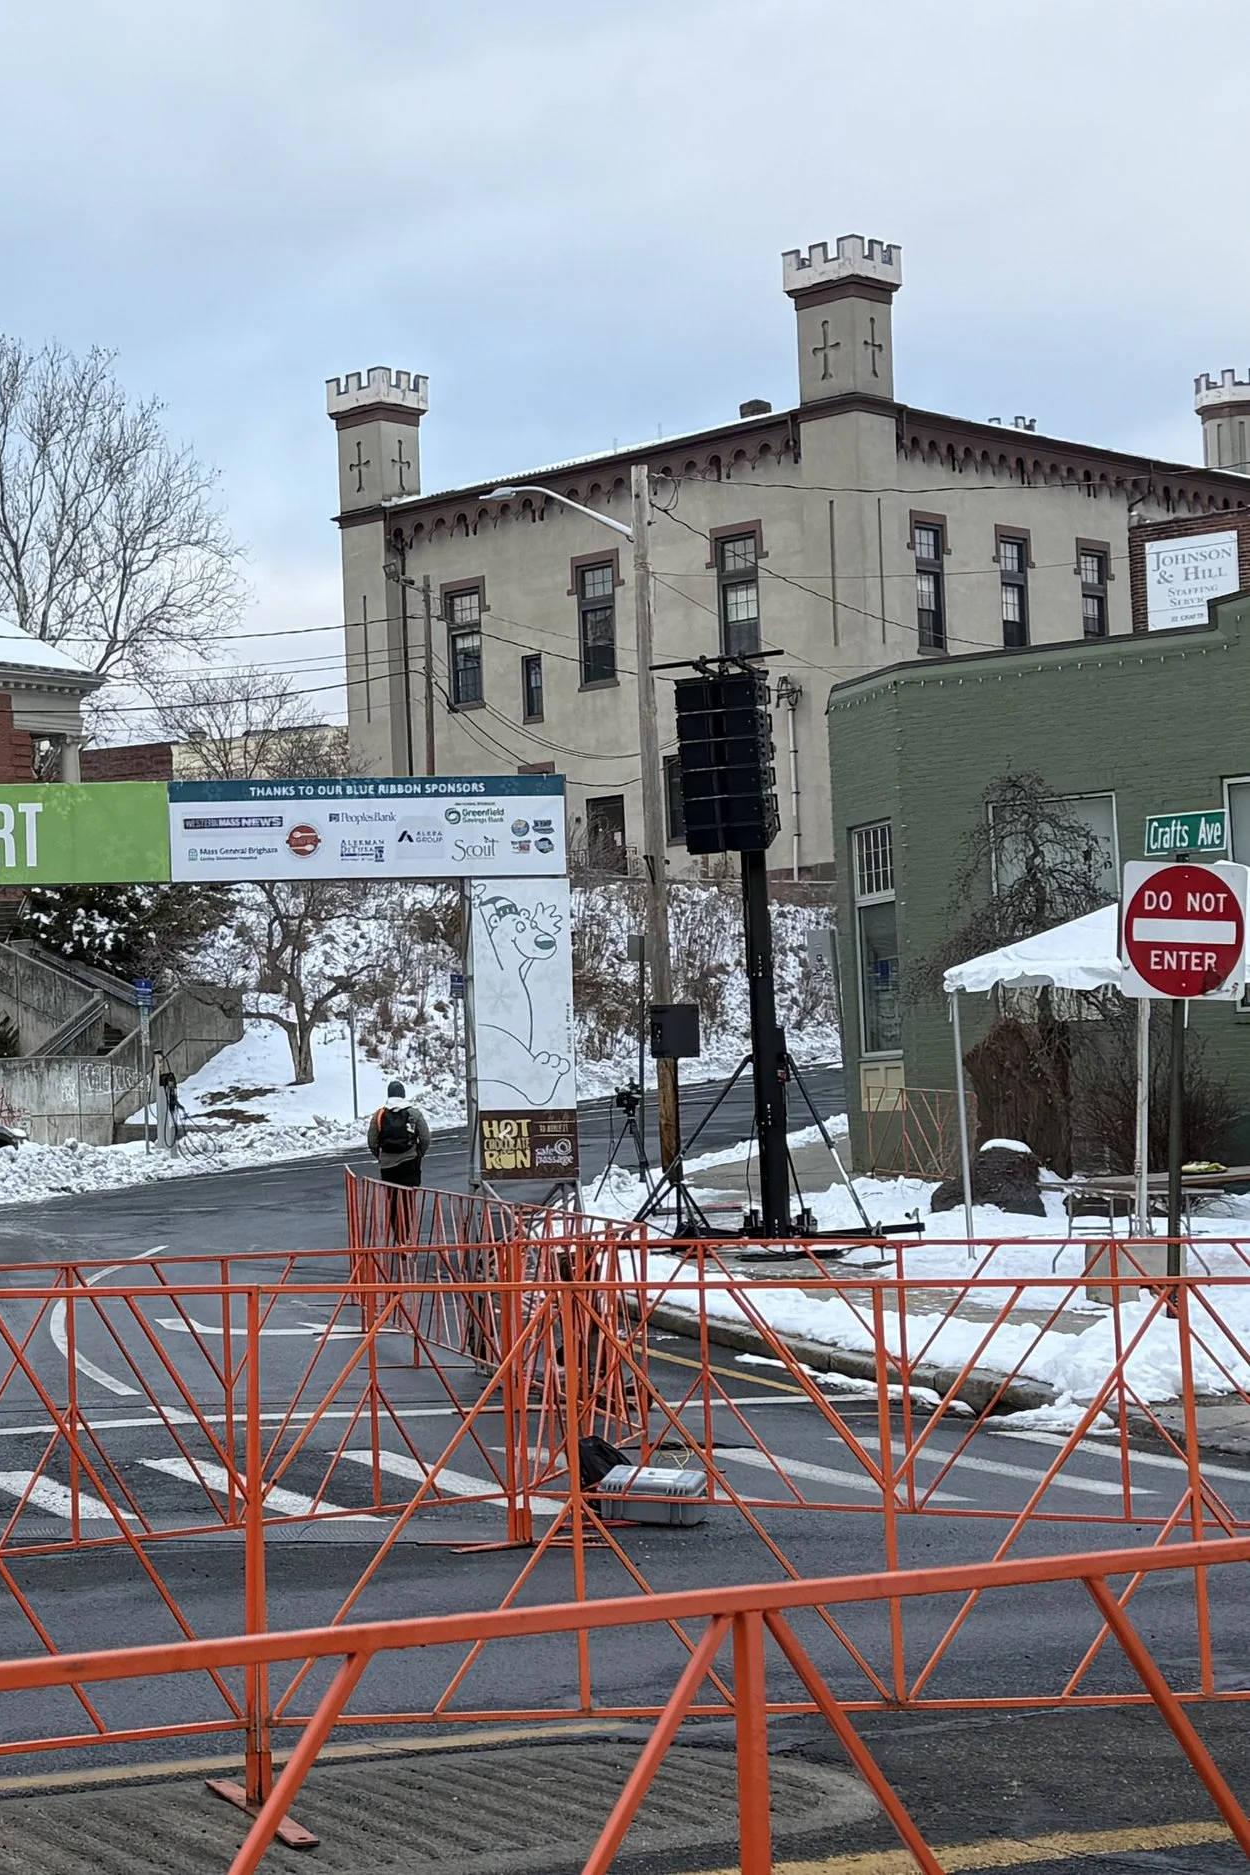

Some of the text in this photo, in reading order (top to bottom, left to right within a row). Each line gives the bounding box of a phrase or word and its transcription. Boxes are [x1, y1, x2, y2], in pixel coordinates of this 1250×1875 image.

[1152, 547, 1232, 572] JOHNSON
[1157, 565, 1228, 585] & HILL
[1168, 584, 1219, 598] STAFFING
[1169, 597, 1206, 607] SERVIC
[249, 782, 486, 797] THANKS TO OUR BLUE RIBBON SPONSORS
[462, 807, 505, 817] Greenfield
[219, 819, 240, 827] MASS
[241, 817, 282, 827] NEWS
[1150, 816, 1222, 850] Crafts Ave
[219, 847, 247, 855] General
[451, 839, 499, 862] Scout
[1144, 890, 1227, 913] DO NOT
[1150, 950, 1217, 972] ENTER
[482, 1119, 531, 1138] HOT
[535, 1145, 554, 1156] safe
[535, 1155, 573, 1167] passage
